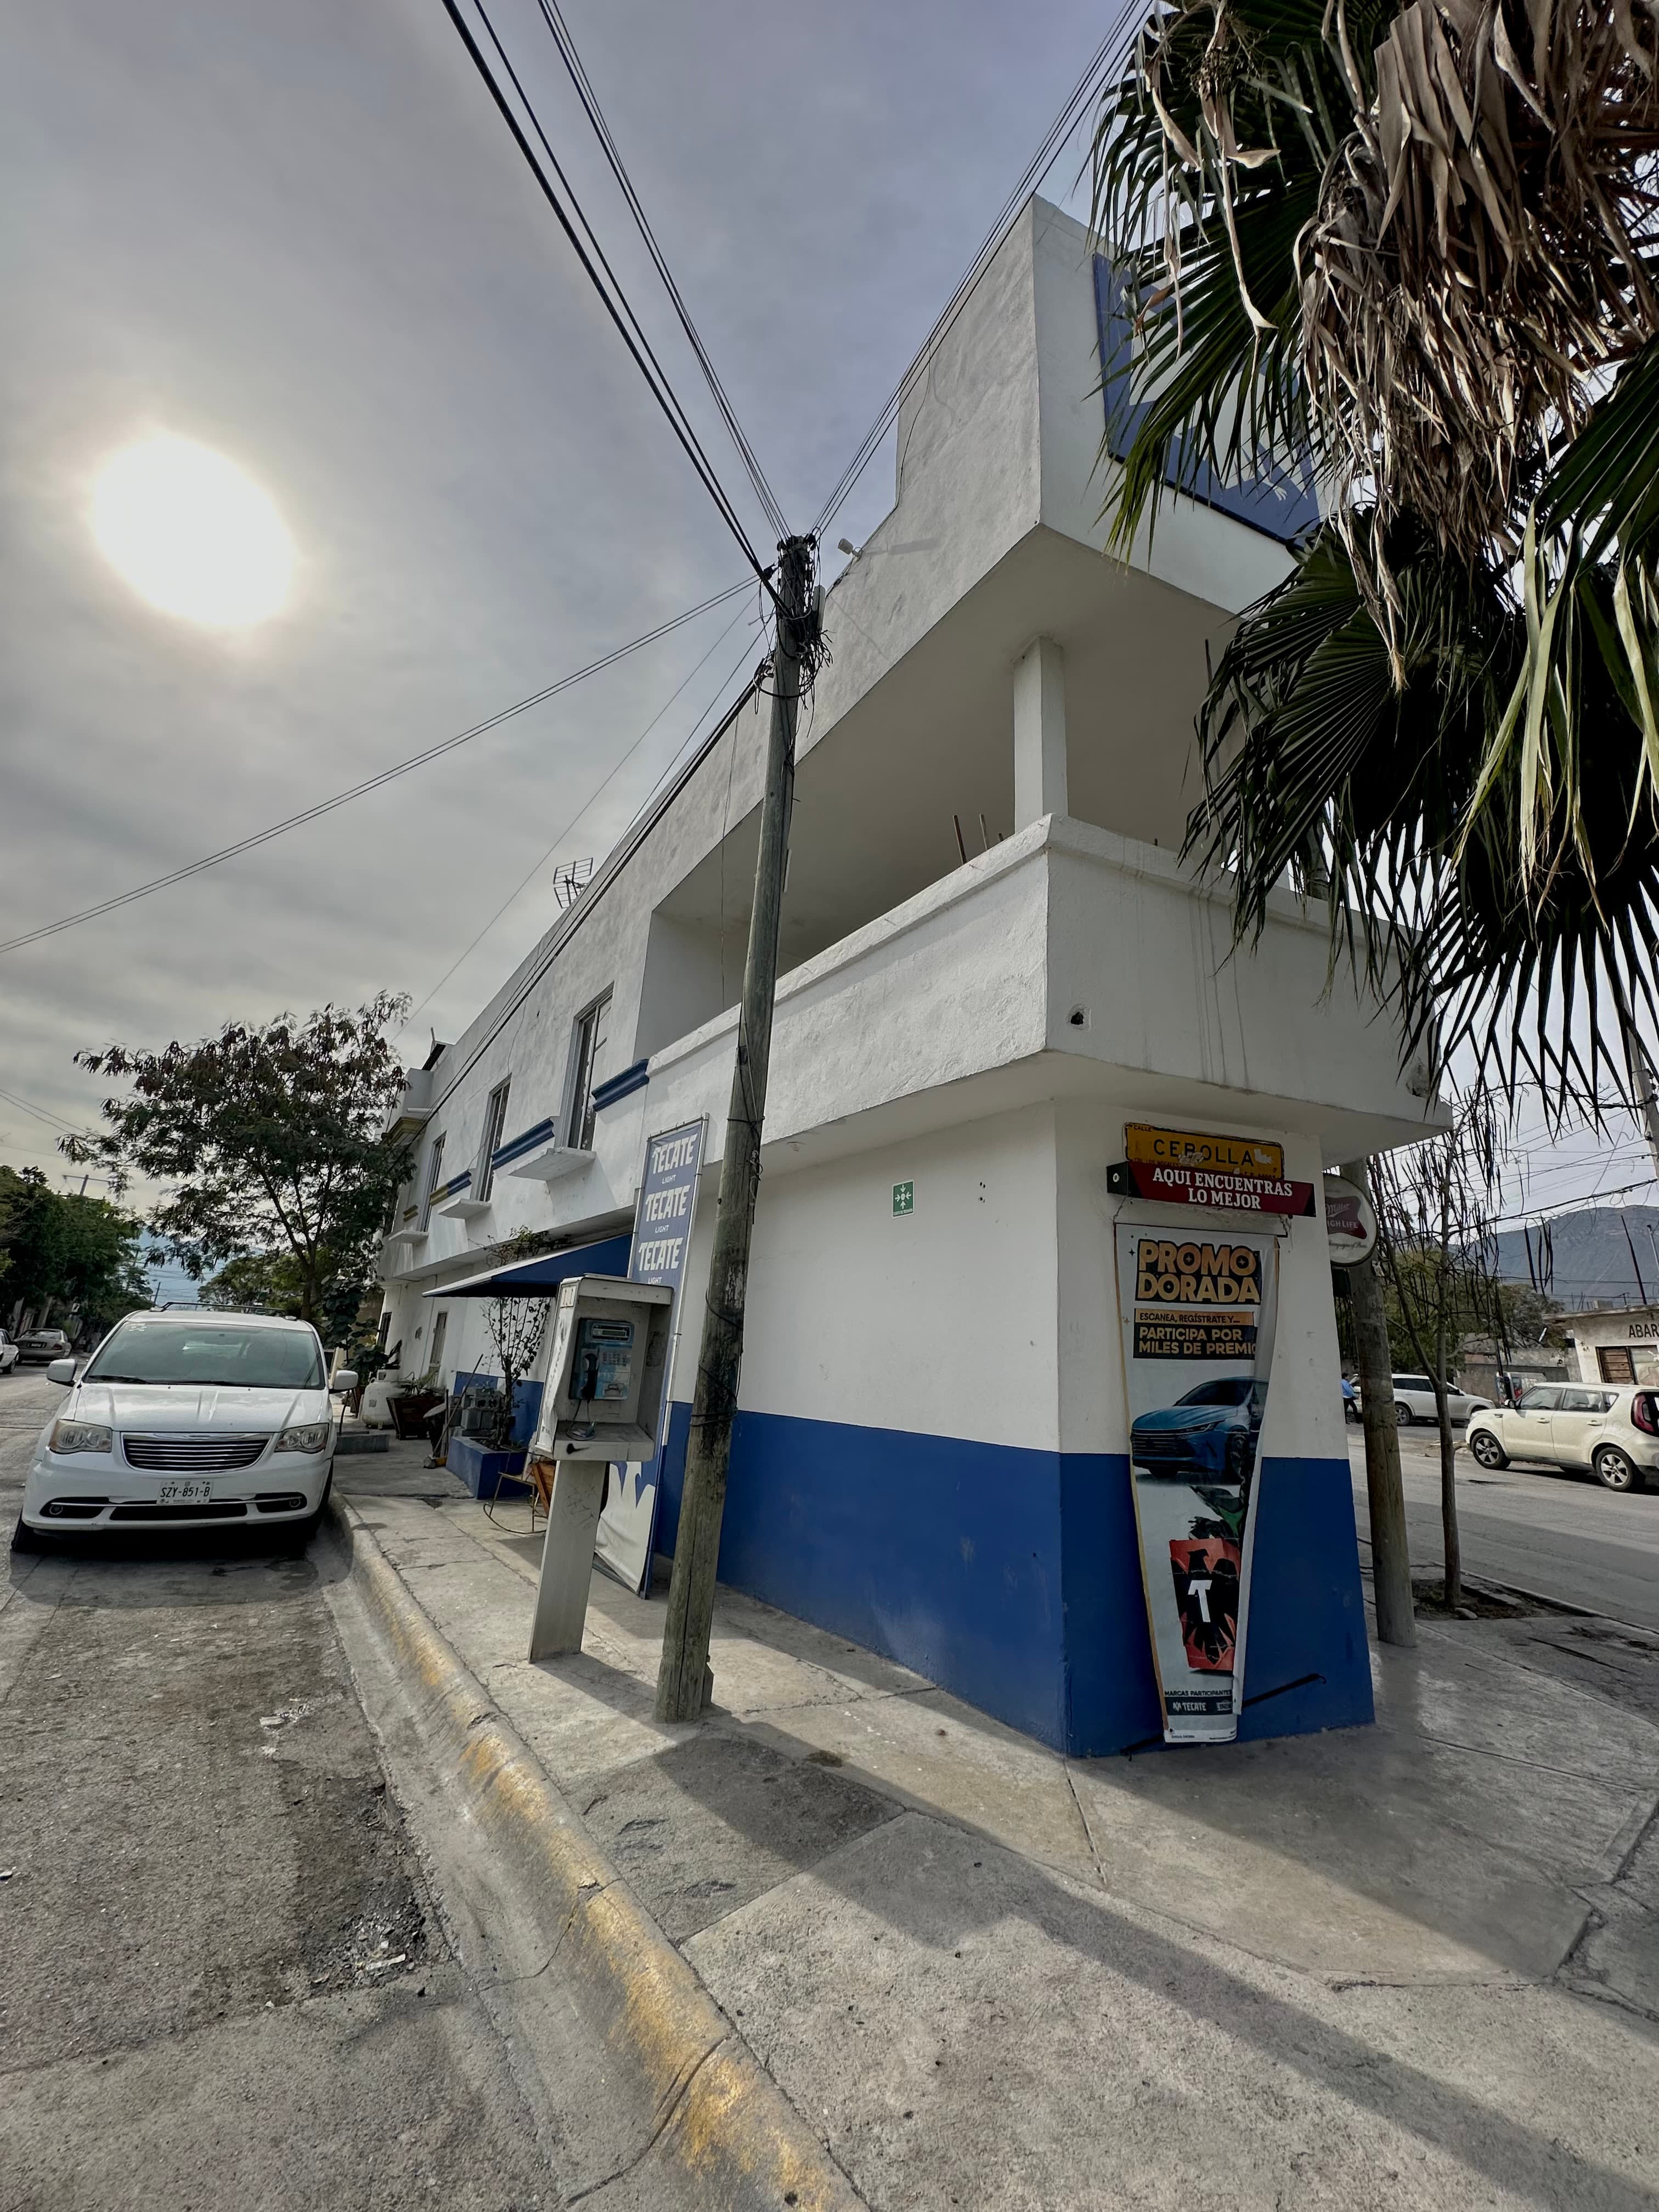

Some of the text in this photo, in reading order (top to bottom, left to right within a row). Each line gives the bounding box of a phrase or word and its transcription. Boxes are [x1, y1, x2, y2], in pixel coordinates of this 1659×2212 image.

[652, 1133, 698, 1175] TECATE
[662, 1175, 676, 1184] LIGHT
[1153, 1167, 1293, 1197] AQUI ENCUENTRAS
[645, 1184, 691, 1222] TECATE
[1188, 1188, 1261, 1210] LO MEJOR
[654, 1224, 670, 1234] LIGHT
[1327, 1219, 1358, 1229] IGH LIFE
[639, 1238, 684, 1272] TECATE
[1139, 1240, 1256, 1277] PROMO
[648, 1277, 663, 1285] LIGHT
[1137, 1272, 1260, 1303] DORADA
[1139, 1313, 1178, 1323] ESCANEA,
[1179, 1313, 1226, 1323] REGÍSTRATE
[1139, 1327, 1243, 1341] PARTICIPA POR
[1139, 1341, 1179, 1354] MILES
[1184, 1342, 1201, 1355] DE
[160, 1487, 210, 1498] SZY-851-B
[1182, 1702, 1207, 1712] TECATE
